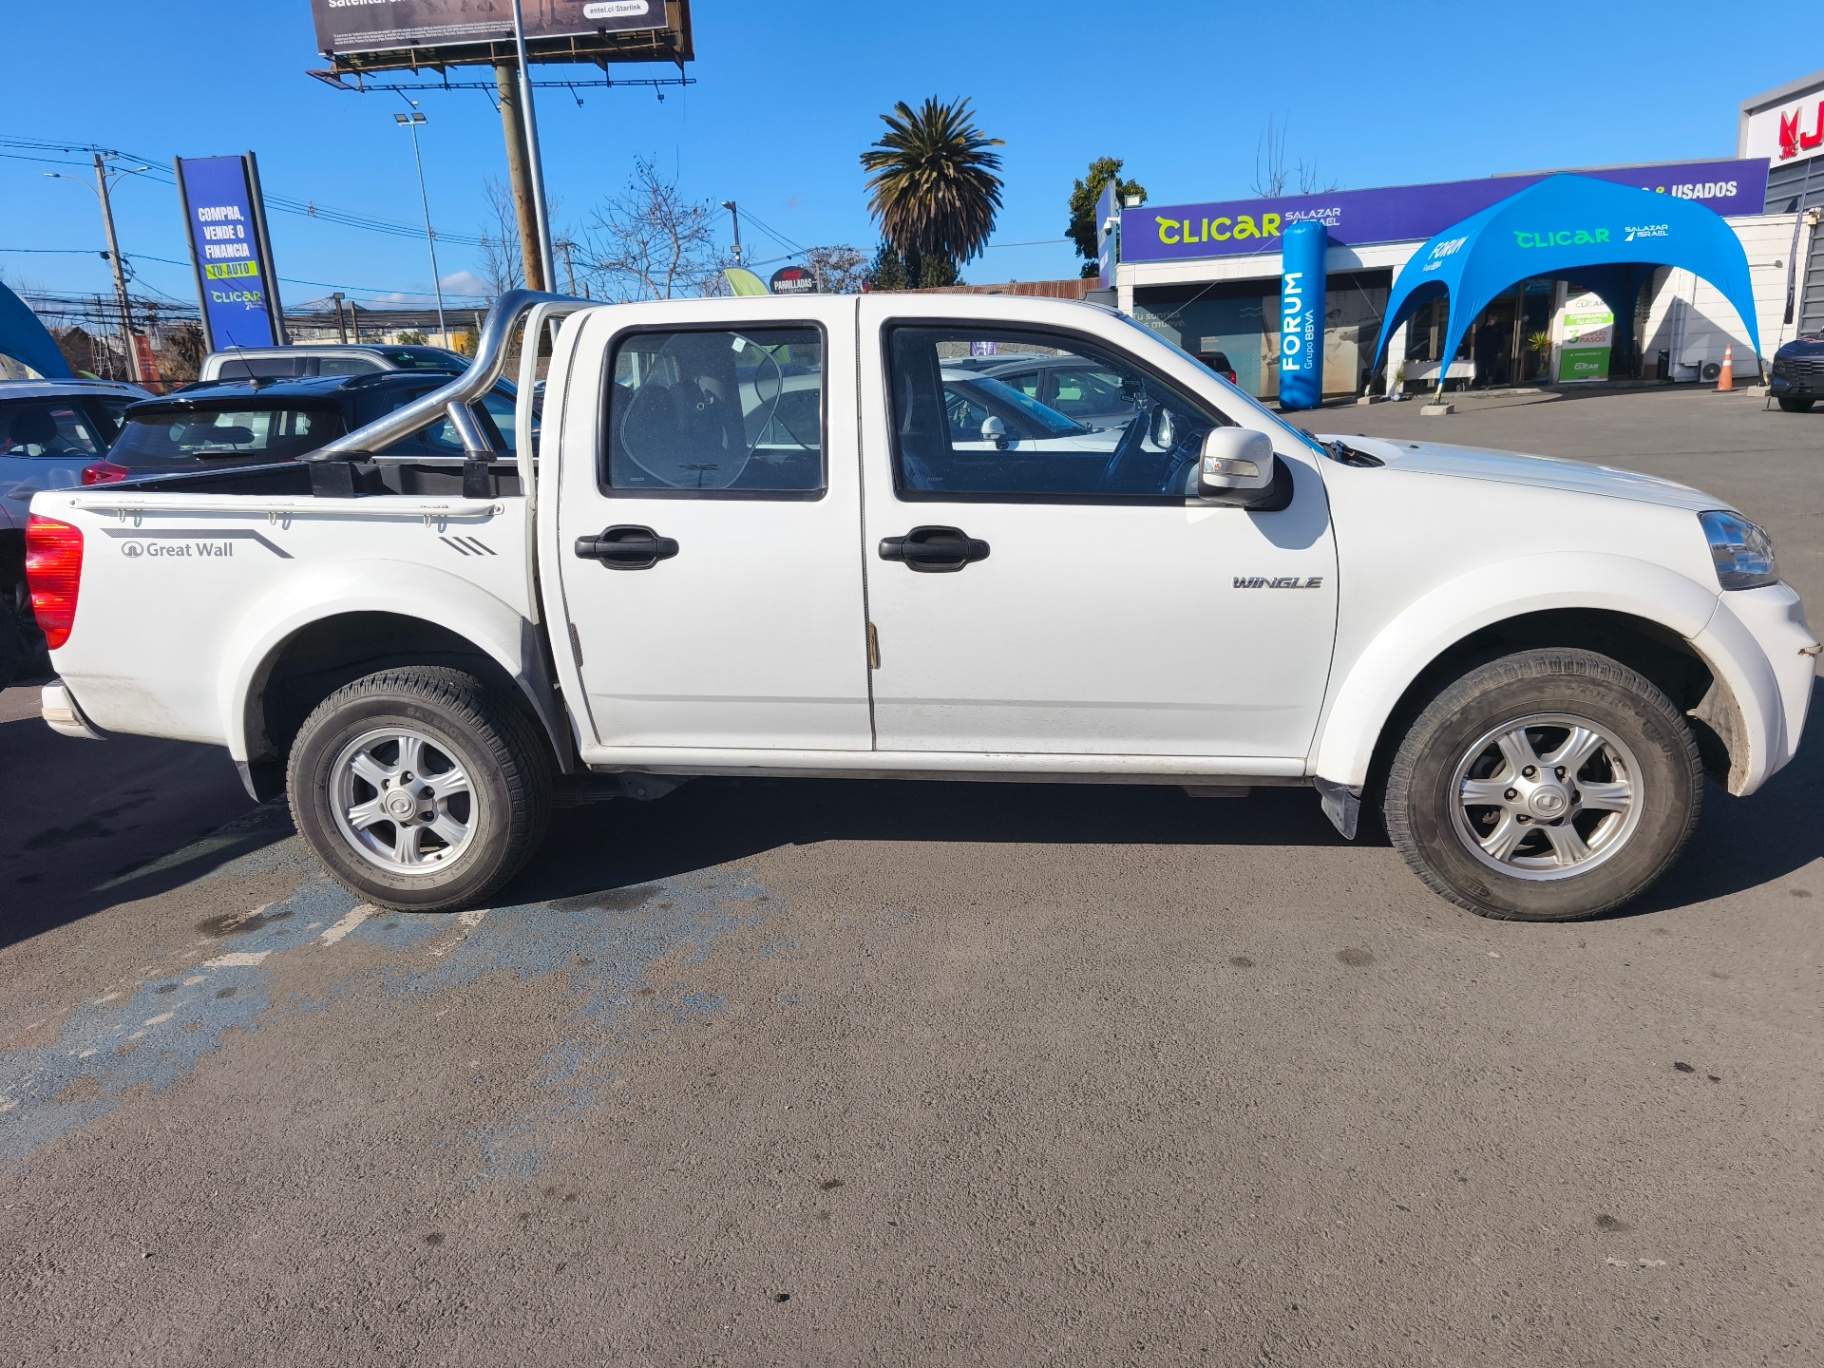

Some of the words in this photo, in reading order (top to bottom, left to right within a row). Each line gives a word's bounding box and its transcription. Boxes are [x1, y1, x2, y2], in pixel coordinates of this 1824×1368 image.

[198, 206, 244, 222] COMPRA,
[1285, 207, 1341, 221] SALAZAR
[203, 225, 235, 240] VENDE
[237, 225, 245, 239] O
[1624, 224, 1669, 232] SALAZAR
[205, 243, 250, 259] FINANCIA
[211, 264, 223, 277] TU
[227, 262, 250, 276] AUTO
[1282, 272, 1303, 371] FORUM
[1304, 309, 1314, 340] BBVA
[1304, 342, 1314, 370] Grupo
[147, 542, 192, 557] Great
[196, 541, 234, 557] Wall
[1232, 576, 1324, 589] WINGLE
